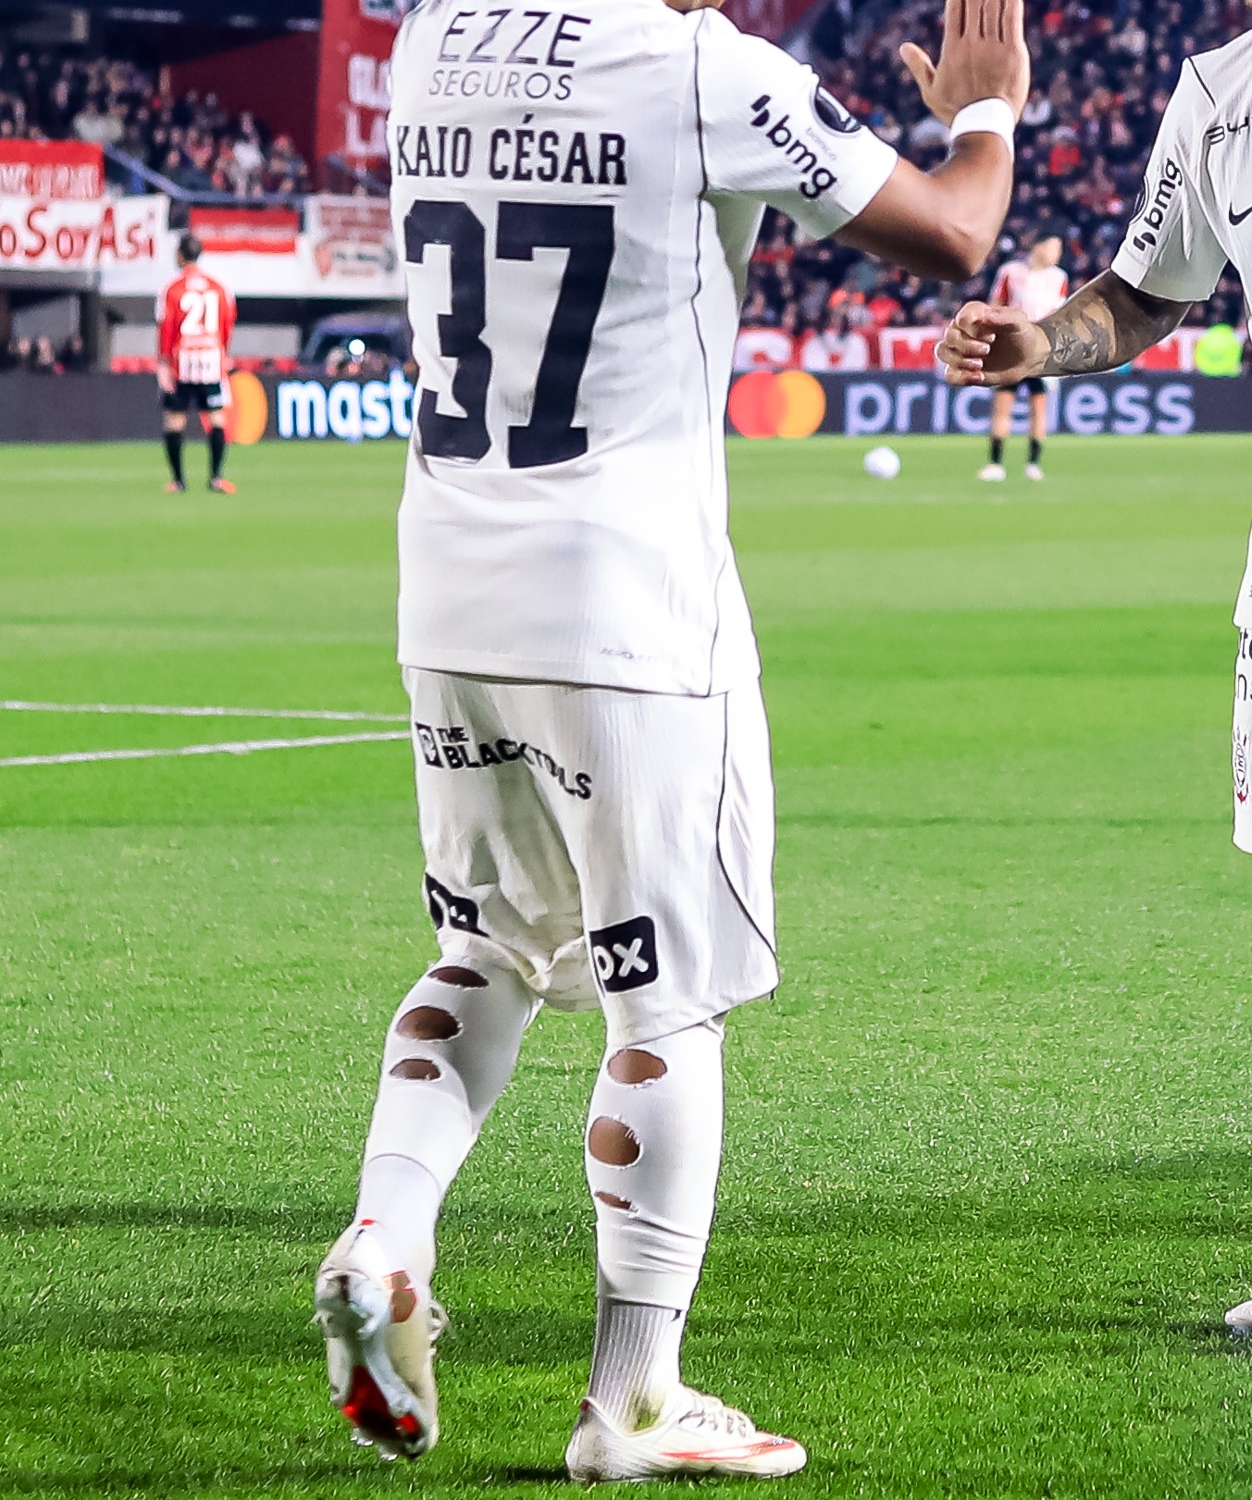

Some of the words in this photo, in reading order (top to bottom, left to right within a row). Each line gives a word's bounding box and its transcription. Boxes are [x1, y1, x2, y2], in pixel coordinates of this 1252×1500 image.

[437, 9, 592, 67] EZZE
[428, 70, 573, 101] SEGUROS
[396, 125, 472, 178] KAIO
[489, 113, 627, 185] CÉSAR
[766, 114, 838, 199] bmg
[1144, 157, 1183, 231] bmg
[179, 290, 220, 336] 21
[404, 199, 616, 469] 37
[436, 727, 469, 743] THE
